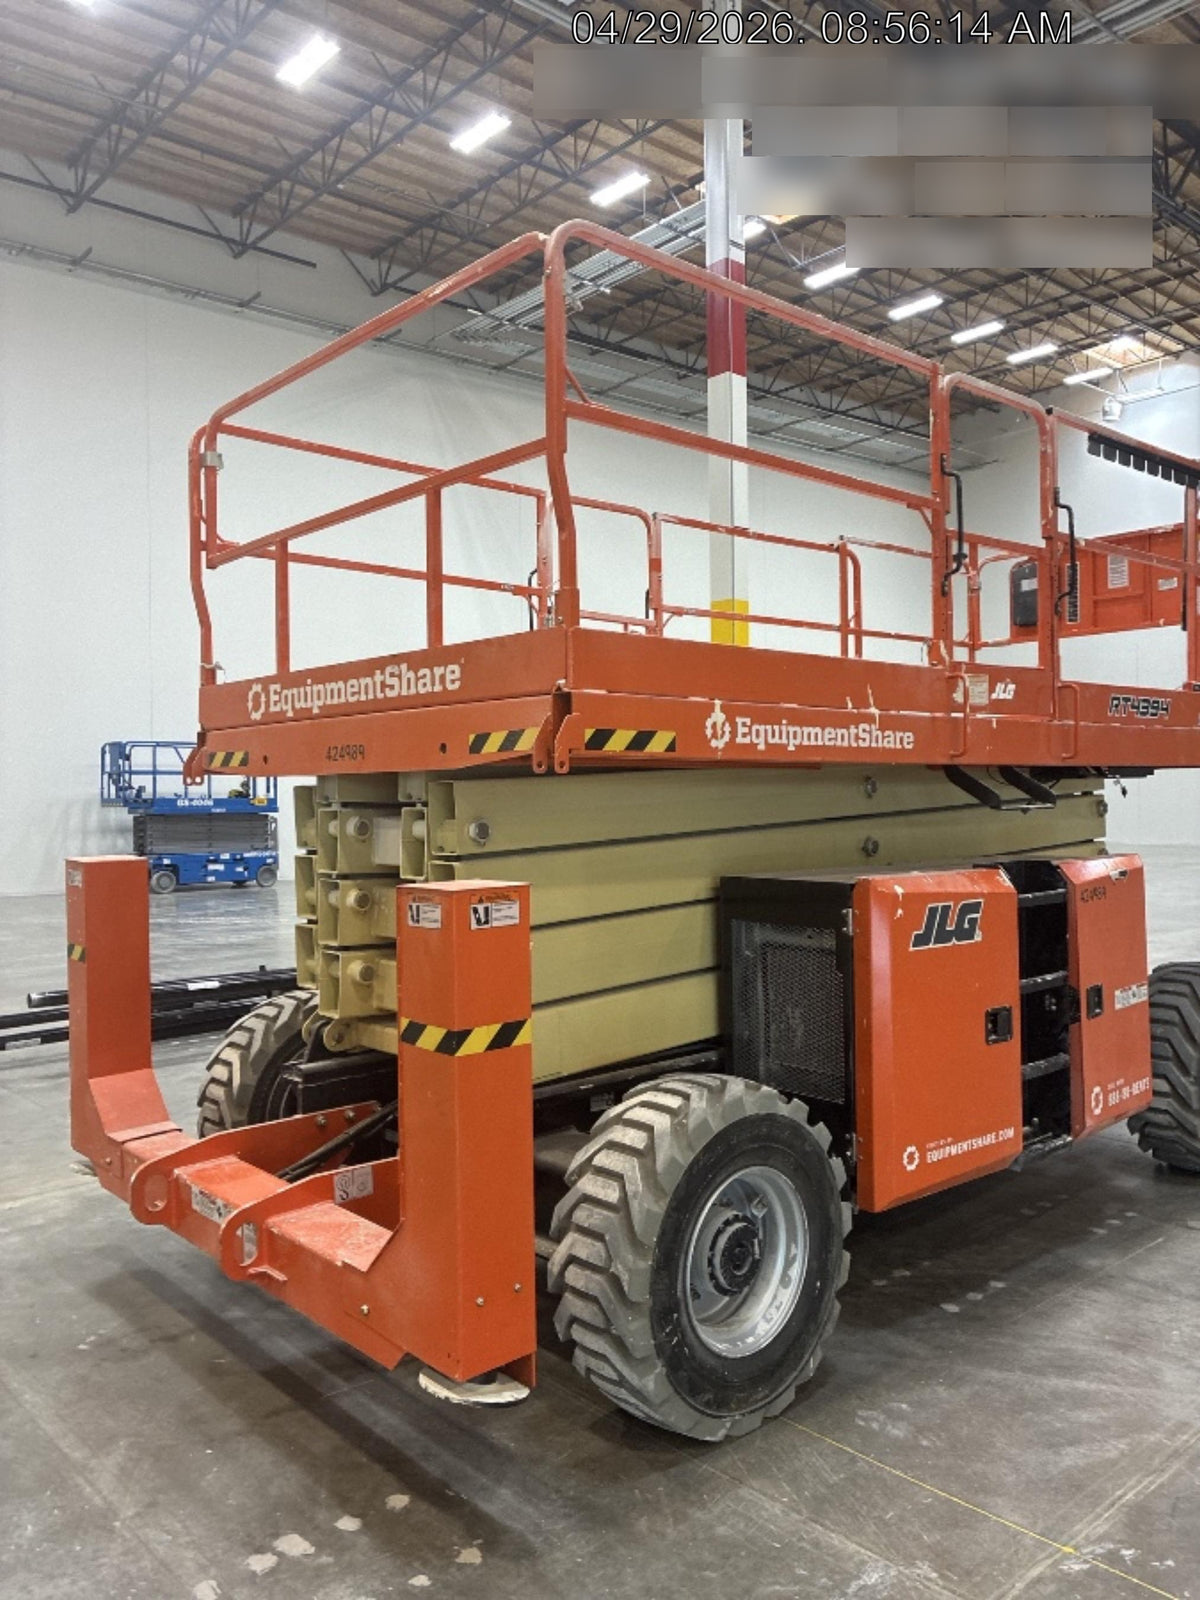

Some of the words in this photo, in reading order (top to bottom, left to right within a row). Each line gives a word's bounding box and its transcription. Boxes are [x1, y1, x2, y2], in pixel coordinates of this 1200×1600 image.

[268, 661, 462, 715] EquipmentShare
[991, 682, 1016, 700] JLG
[1107, 693, 1172, 720] RT4394
[735, 716, 915, 751] EquipmentShare
[325, 744, 365, 762] 424989
[909, 898, 984, 951] JLG
[926, 1126, 1015, 1163] EQUIPMENTSHARE.COM
